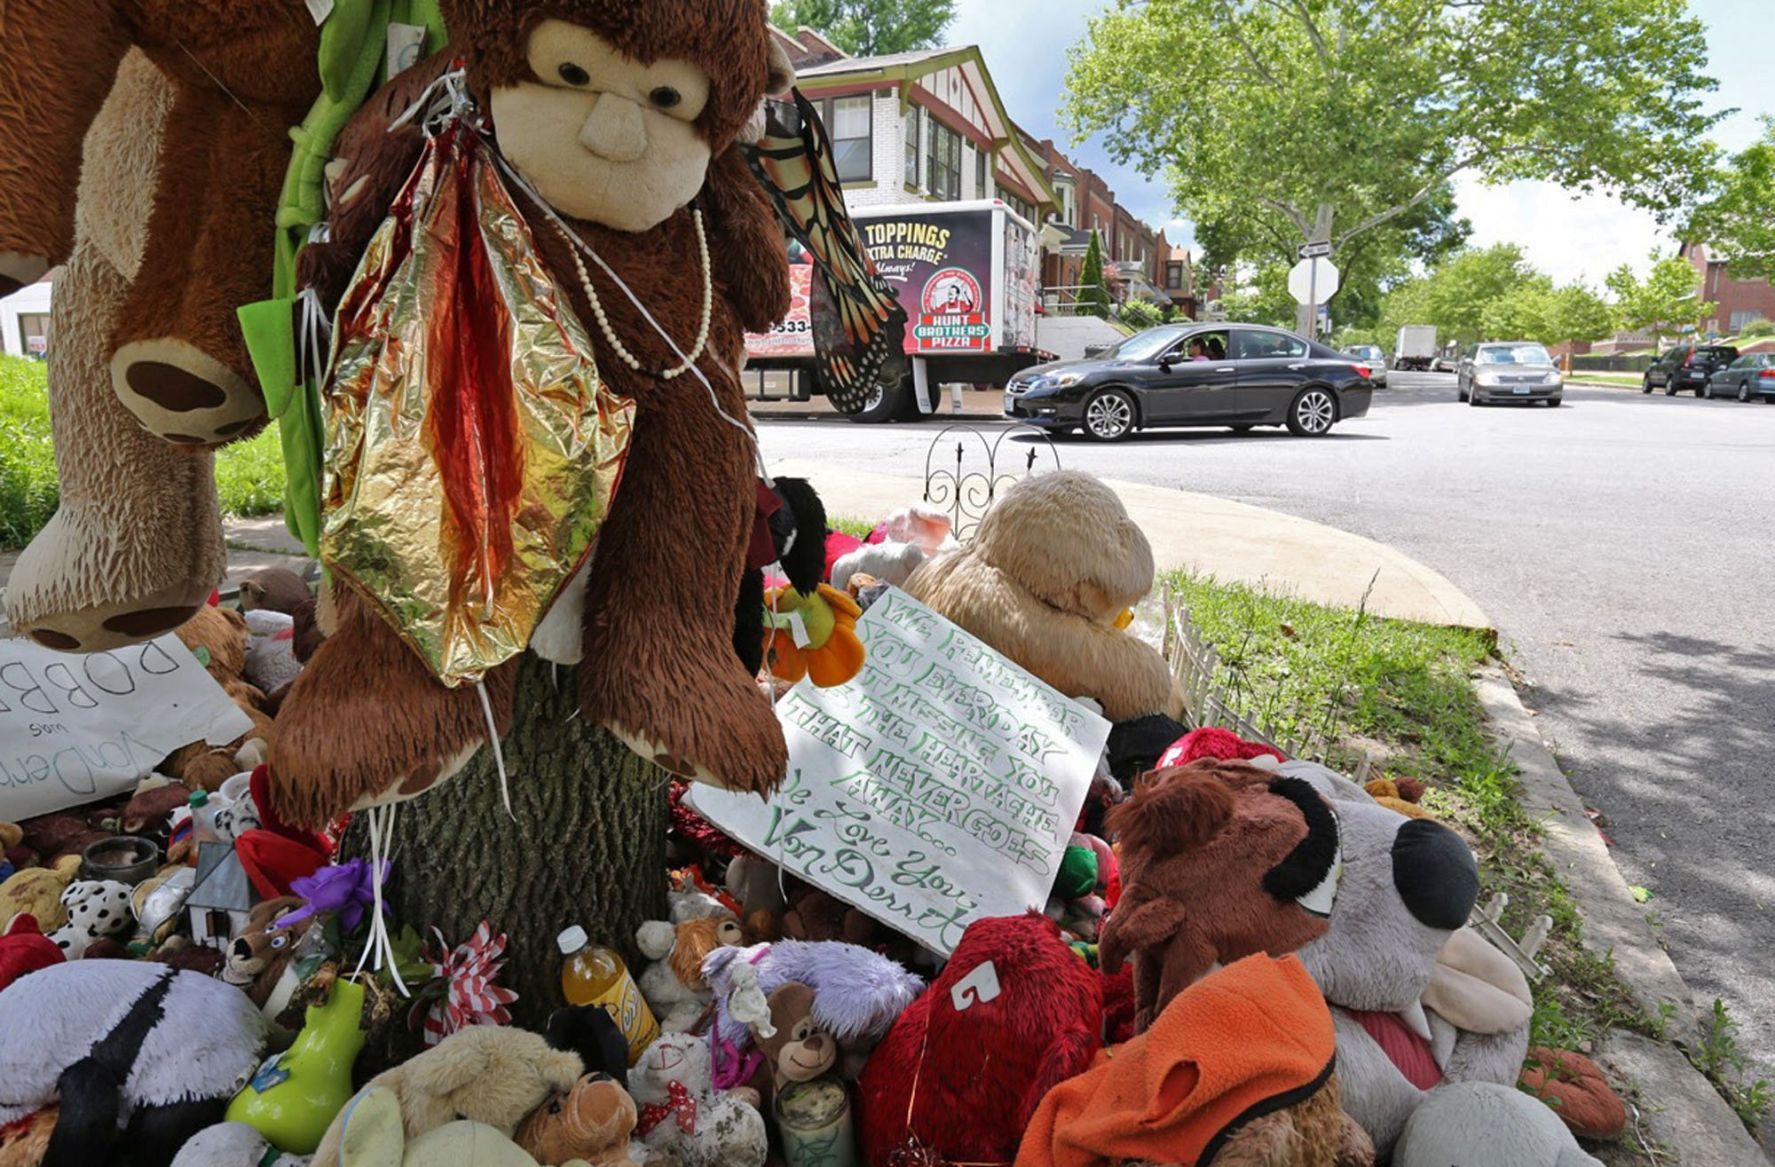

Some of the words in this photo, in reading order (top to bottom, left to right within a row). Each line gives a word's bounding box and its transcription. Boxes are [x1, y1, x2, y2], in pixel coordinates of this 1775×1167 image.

[865, 222, 950, 249] TOPPINGS
[866, 245, 895, 260] XTRA
[897, 244, 944, 266] CHARGE
[918, 326, 985, 337] BROTHERS
[932, 337, 970, 347] PIZZA
[933, 315, 968, 326] HUNT
[881, 594, 938, 640] WE
[863, 619, 923, 677] YOU
[881, 683, 999, 766] MISSING
[1005, 755, 1059, 807] YOU
[783, 692, 872, 759] THAT
[865, 749, 970, 829] NEVER
[963, 809, 1051, 875] GOES
[855, 695, 916, 748] THE
[910, 731, 1060, 843] HEARTACHE
[813, 800, 891, 856] Love
